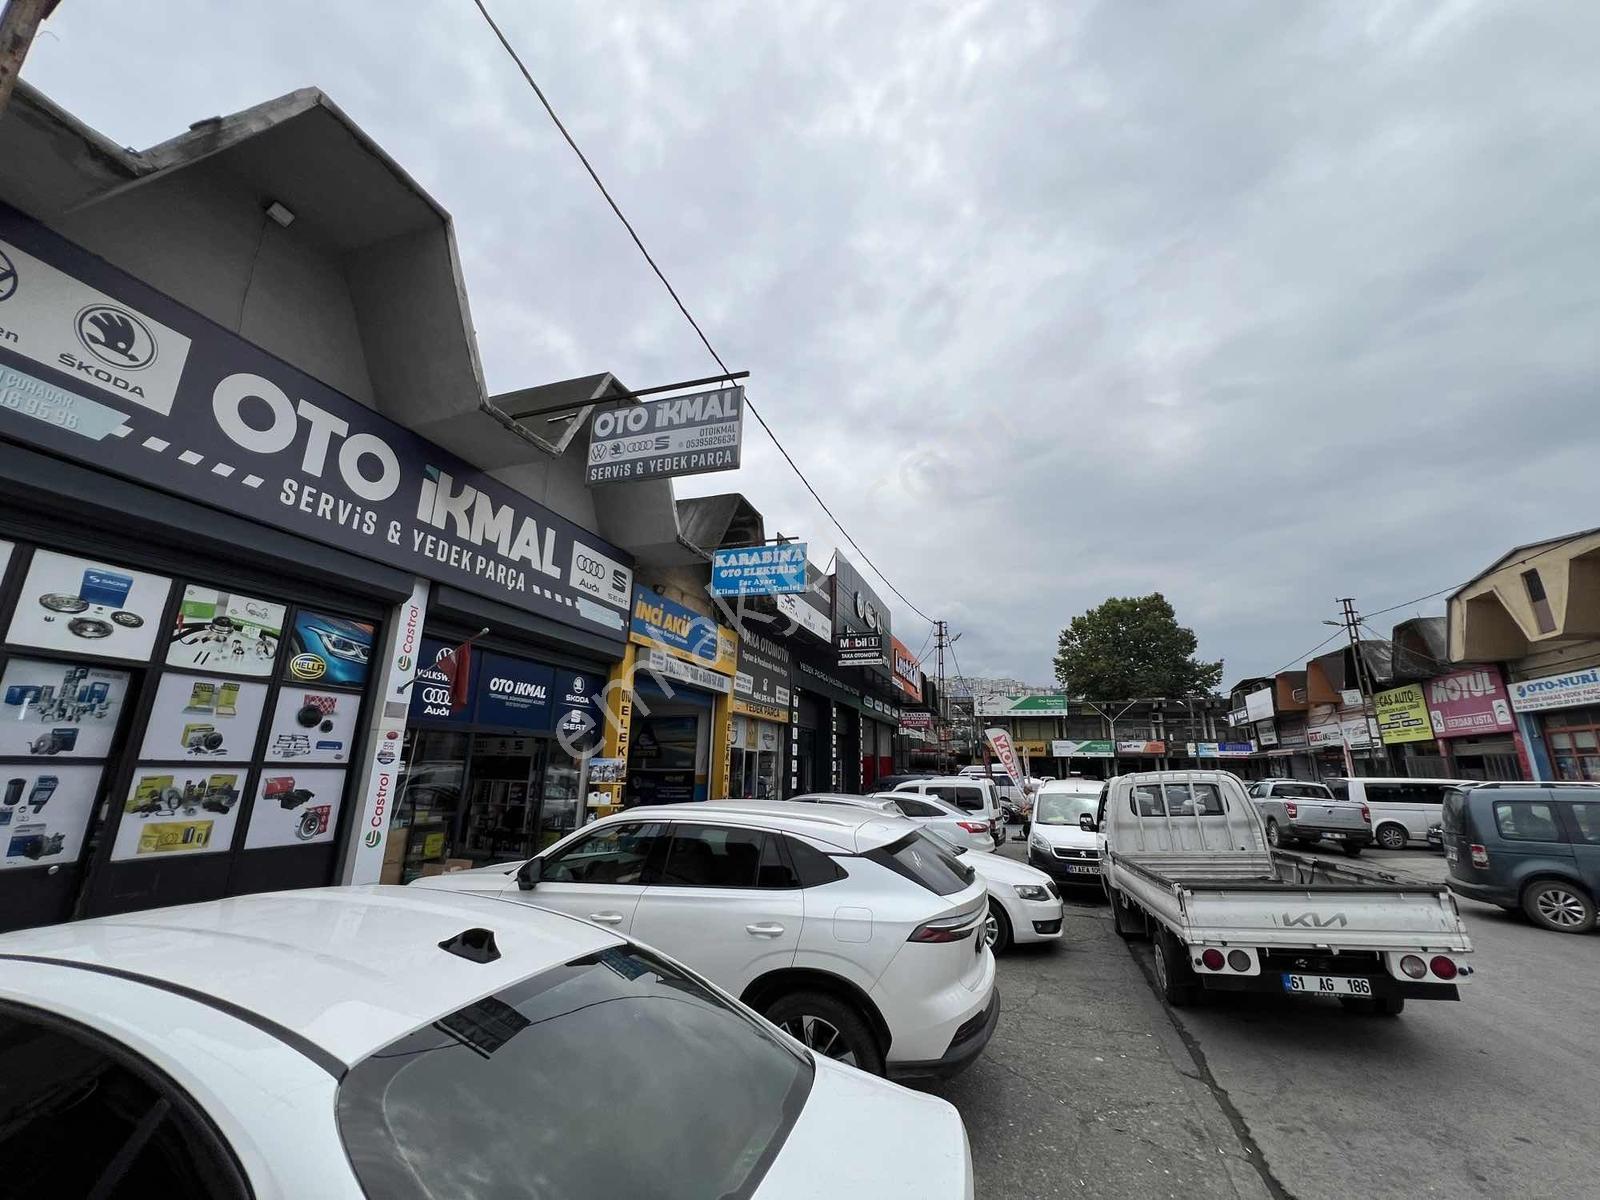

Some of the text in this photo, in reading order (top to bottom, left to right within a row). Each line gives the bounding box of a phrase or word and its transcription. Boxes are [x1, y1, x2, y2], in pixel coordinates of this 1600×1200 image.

[594, 407, 650, 438] OTO
[212, 373, 401, 501] OTO
[636, 461, 645, 475] &
[650, 453, 692, 473] YEDEK
[690, 450, 732, 469] PARÇA
[387, 520, 402, 545] &
[412, 528, 472, 572] YEDEK
[475, 554, 526, 592] PARÇA
[720, 567, 742, 578] OTO
[578, 577, 601, 594] Audi
[403, 604, 420, 655] Castrol
[840, 637, 867, 648] Mobil
[294, 660, 325, 673] HELLA
[417, 668, 450, 682] VOLKSW
[489, 676, 514, 694] OTO
[1432, 672, 1496, 704] MOTUL
[424, 704, 450, 717] Audi
[371, 773, 390, 828] Castrol
[1291, 975, 1370, 993] 61 AG 186
